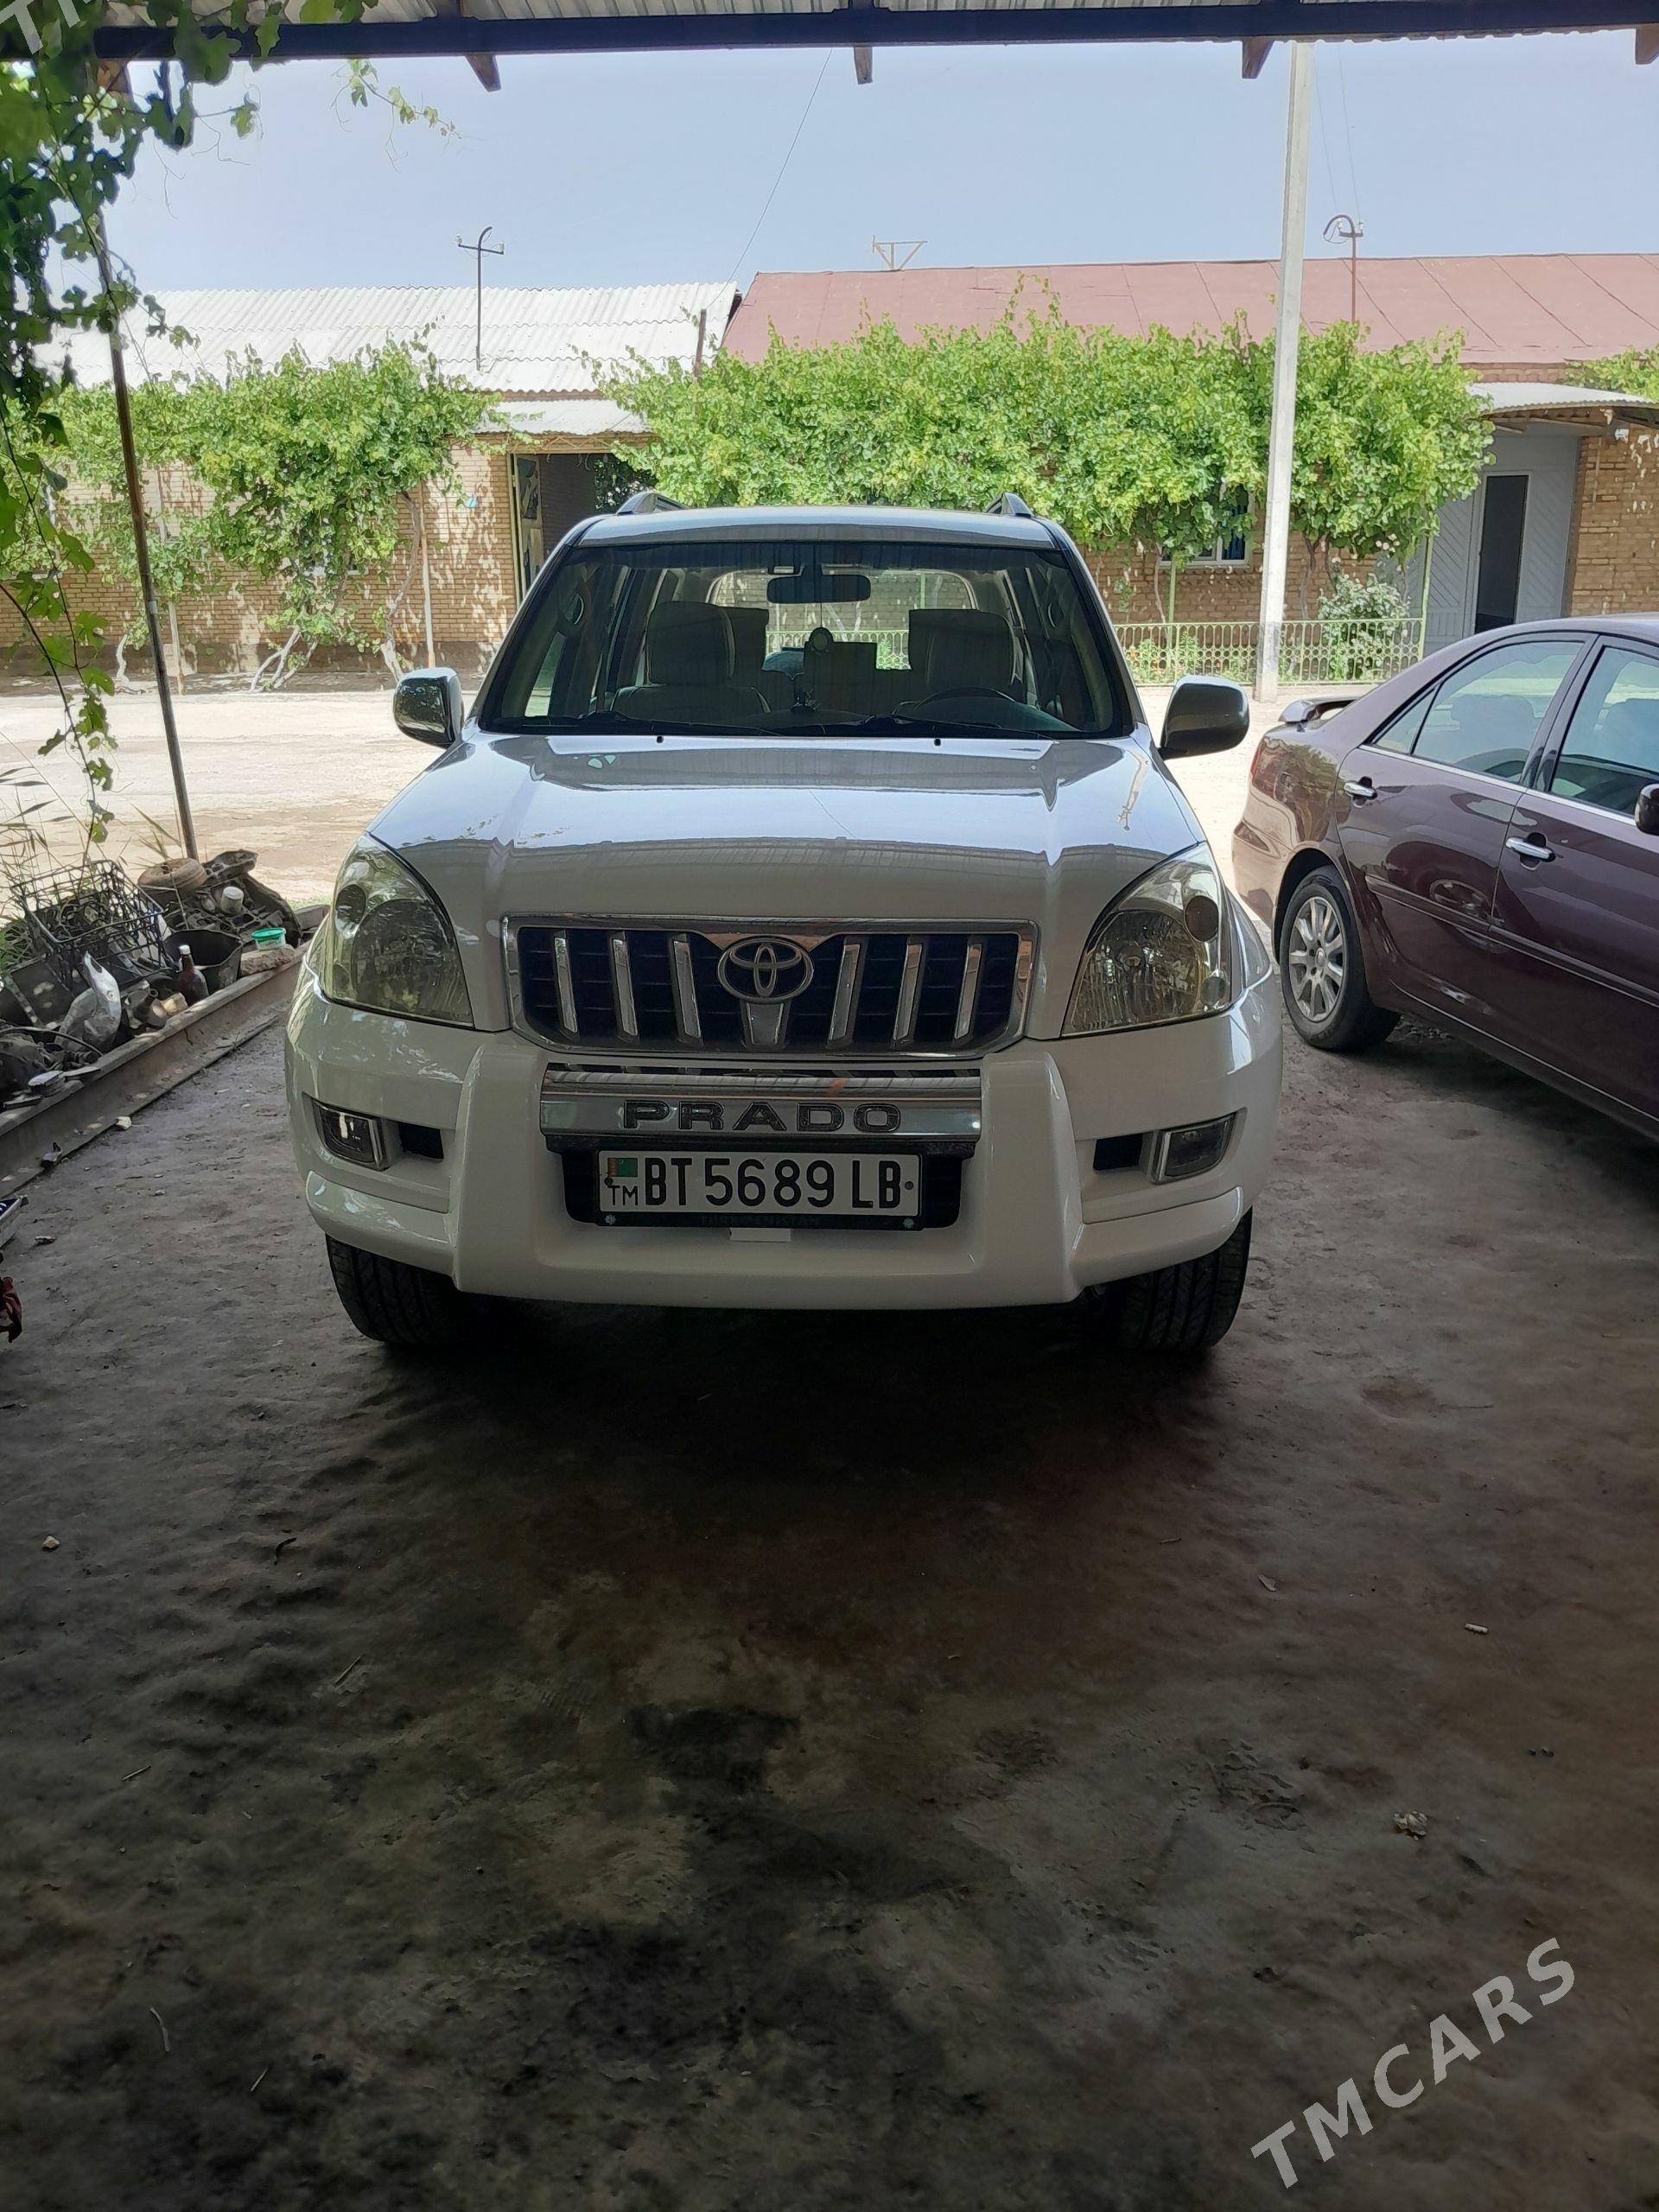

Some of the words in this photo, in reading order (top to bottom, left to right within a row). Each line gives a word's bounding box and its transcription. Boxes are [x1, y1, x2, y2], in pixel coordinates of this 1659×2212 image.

[624, 1099, 901, 1133] PRADO
[607, 1185, 638, 1205] TM
[645, 1157, 692, 1206] BT
[704, 1158, 835, 1207] 5689
[852, 1160, 901, 1208] LB
